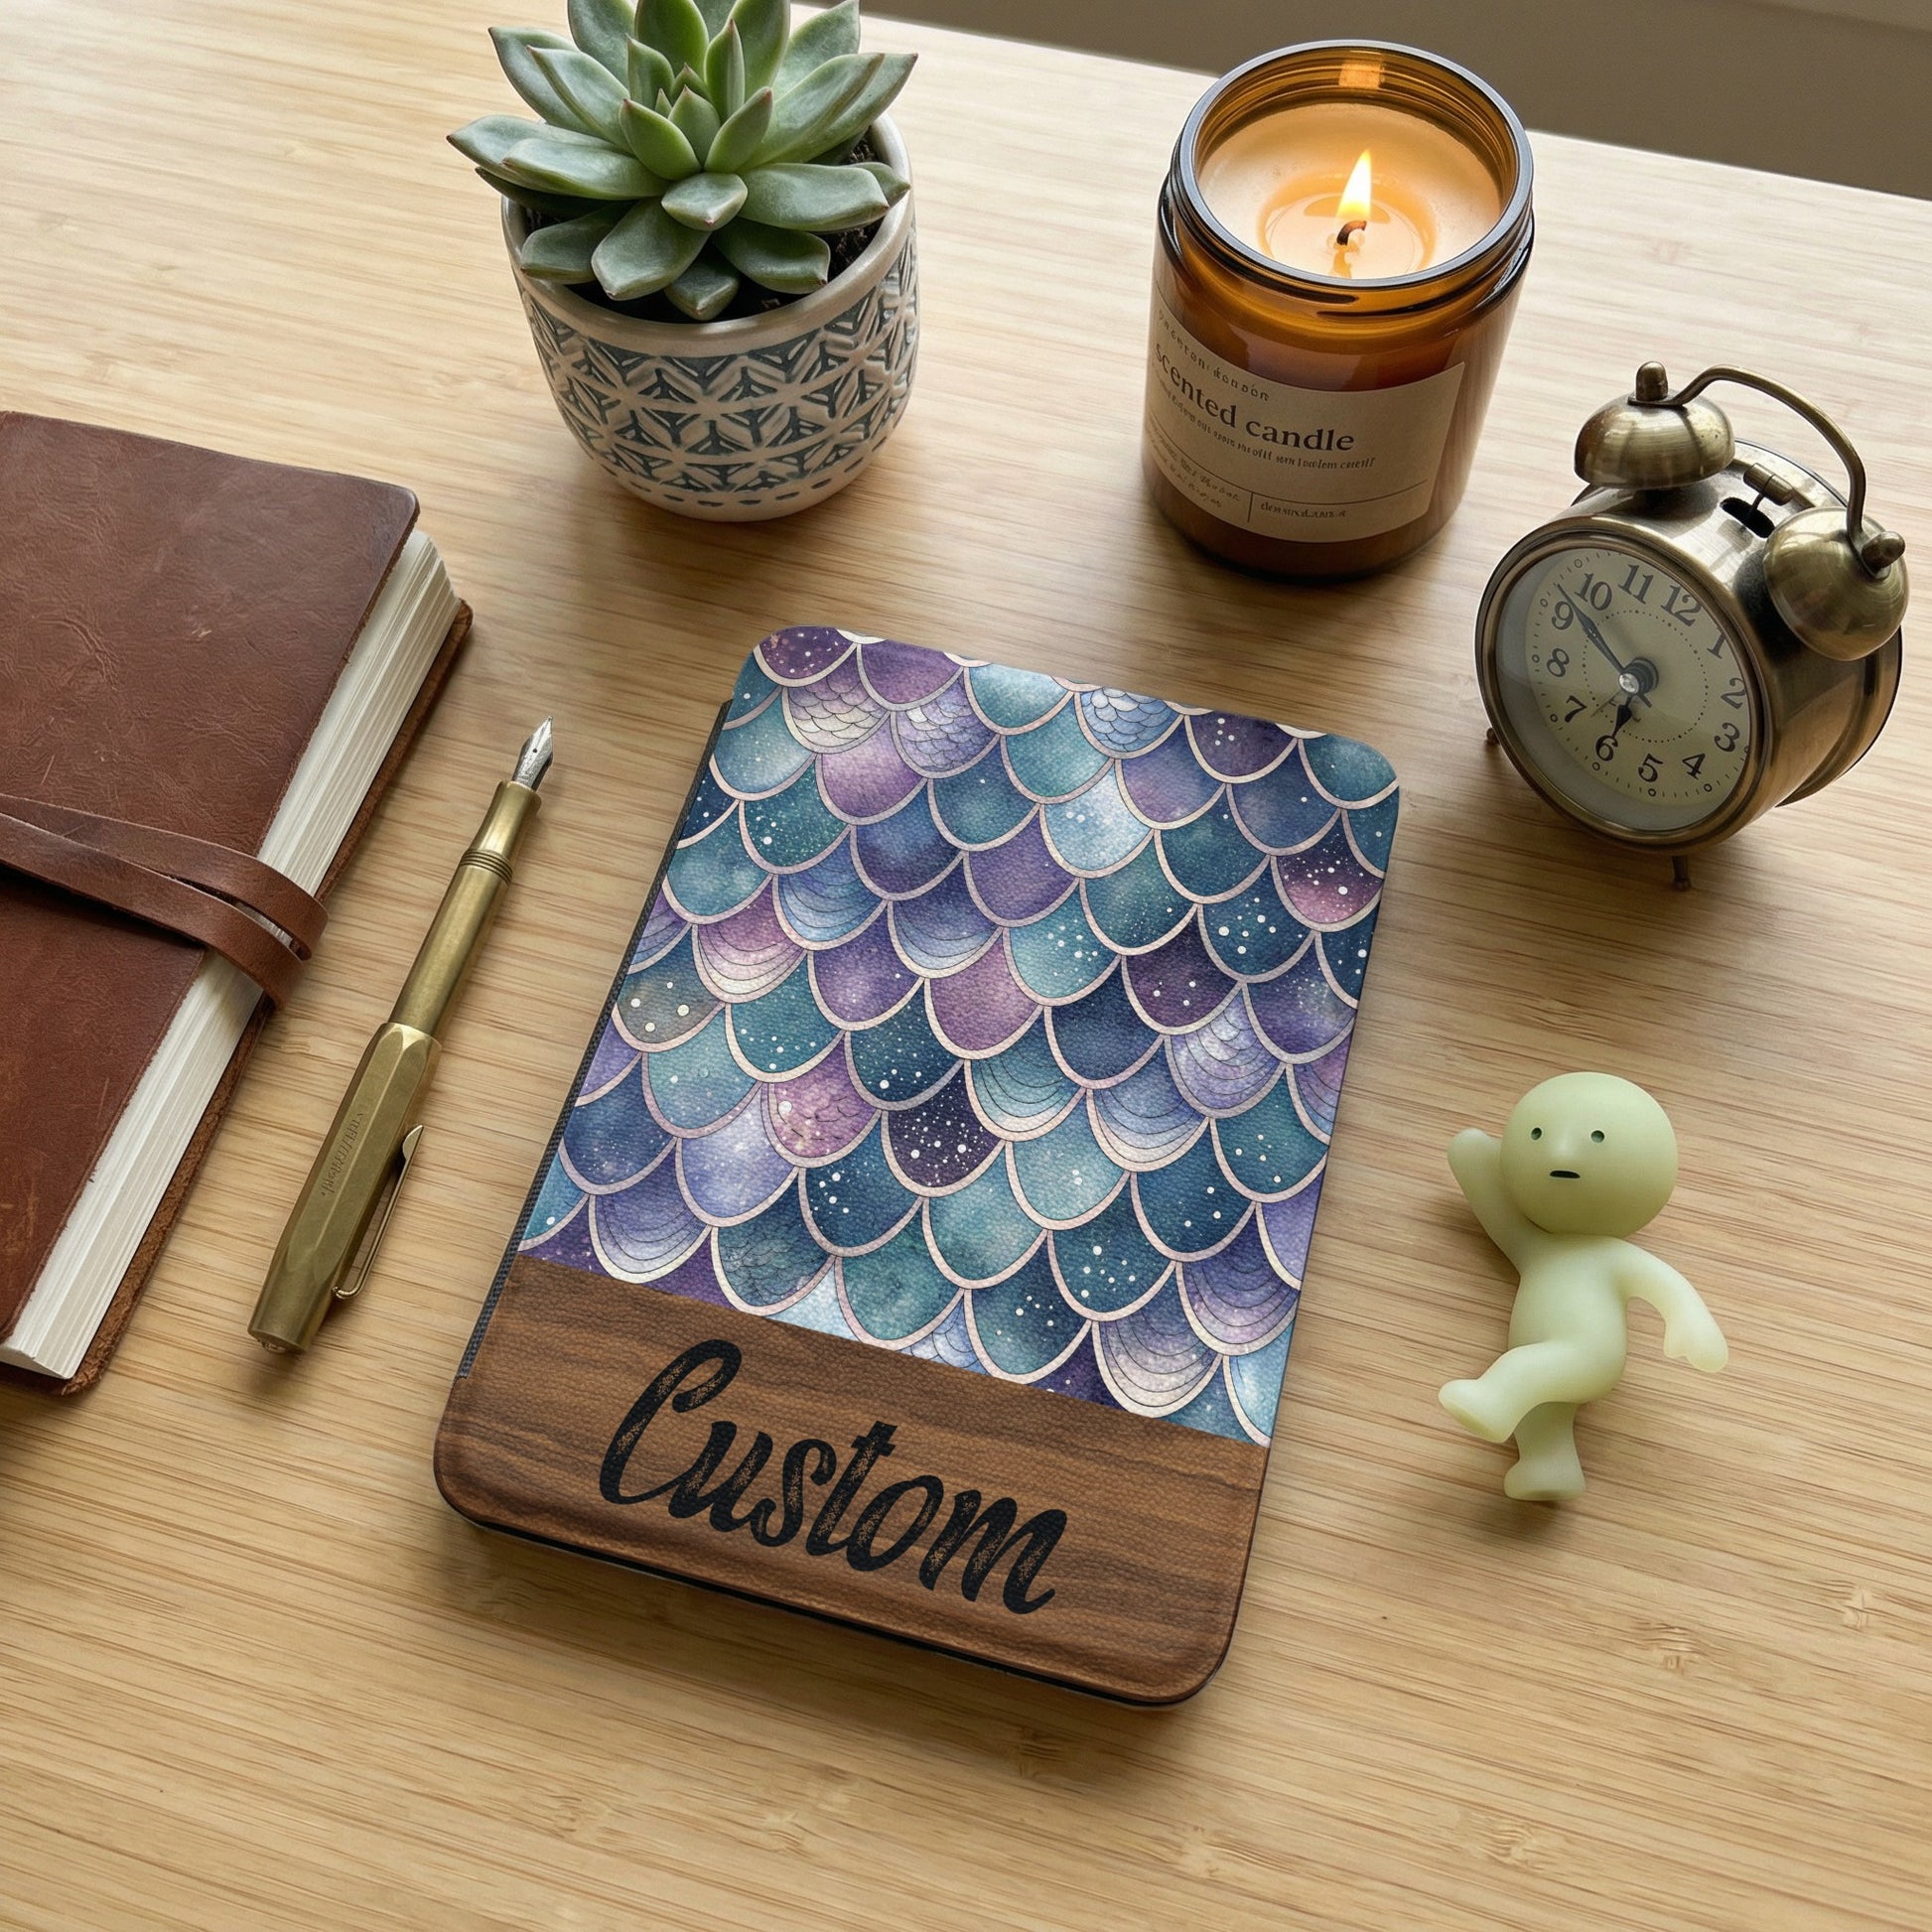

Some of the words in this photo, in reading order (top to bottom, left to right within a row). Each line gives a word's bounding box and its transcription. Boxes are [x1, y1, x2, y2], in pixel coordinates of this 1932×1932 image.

[1155, 343, 1237, 428] scented
[1245, 420, 1355, 451] candle
[1574, 573, 1613, 612] 10
[1617, 564, 1655, 605] 11
[1551, 601, 1575, 630] 9
[1660, 585, 1703, 627] 12
[1707, 627, 1726, 660] 1
[1546, 647, 1570, 678] 8
[1564, 695, 1587, 724] 7
[1721, 677, 1746, 710] 2
[1594, 735, 1618, 762] 6
[1714, 722, 1740, 753] 3
[1637, 753, 1664, 782] 5
[1682, 753, 1707, 780] 4
[599, 1338, 1068, 1614] Custom
